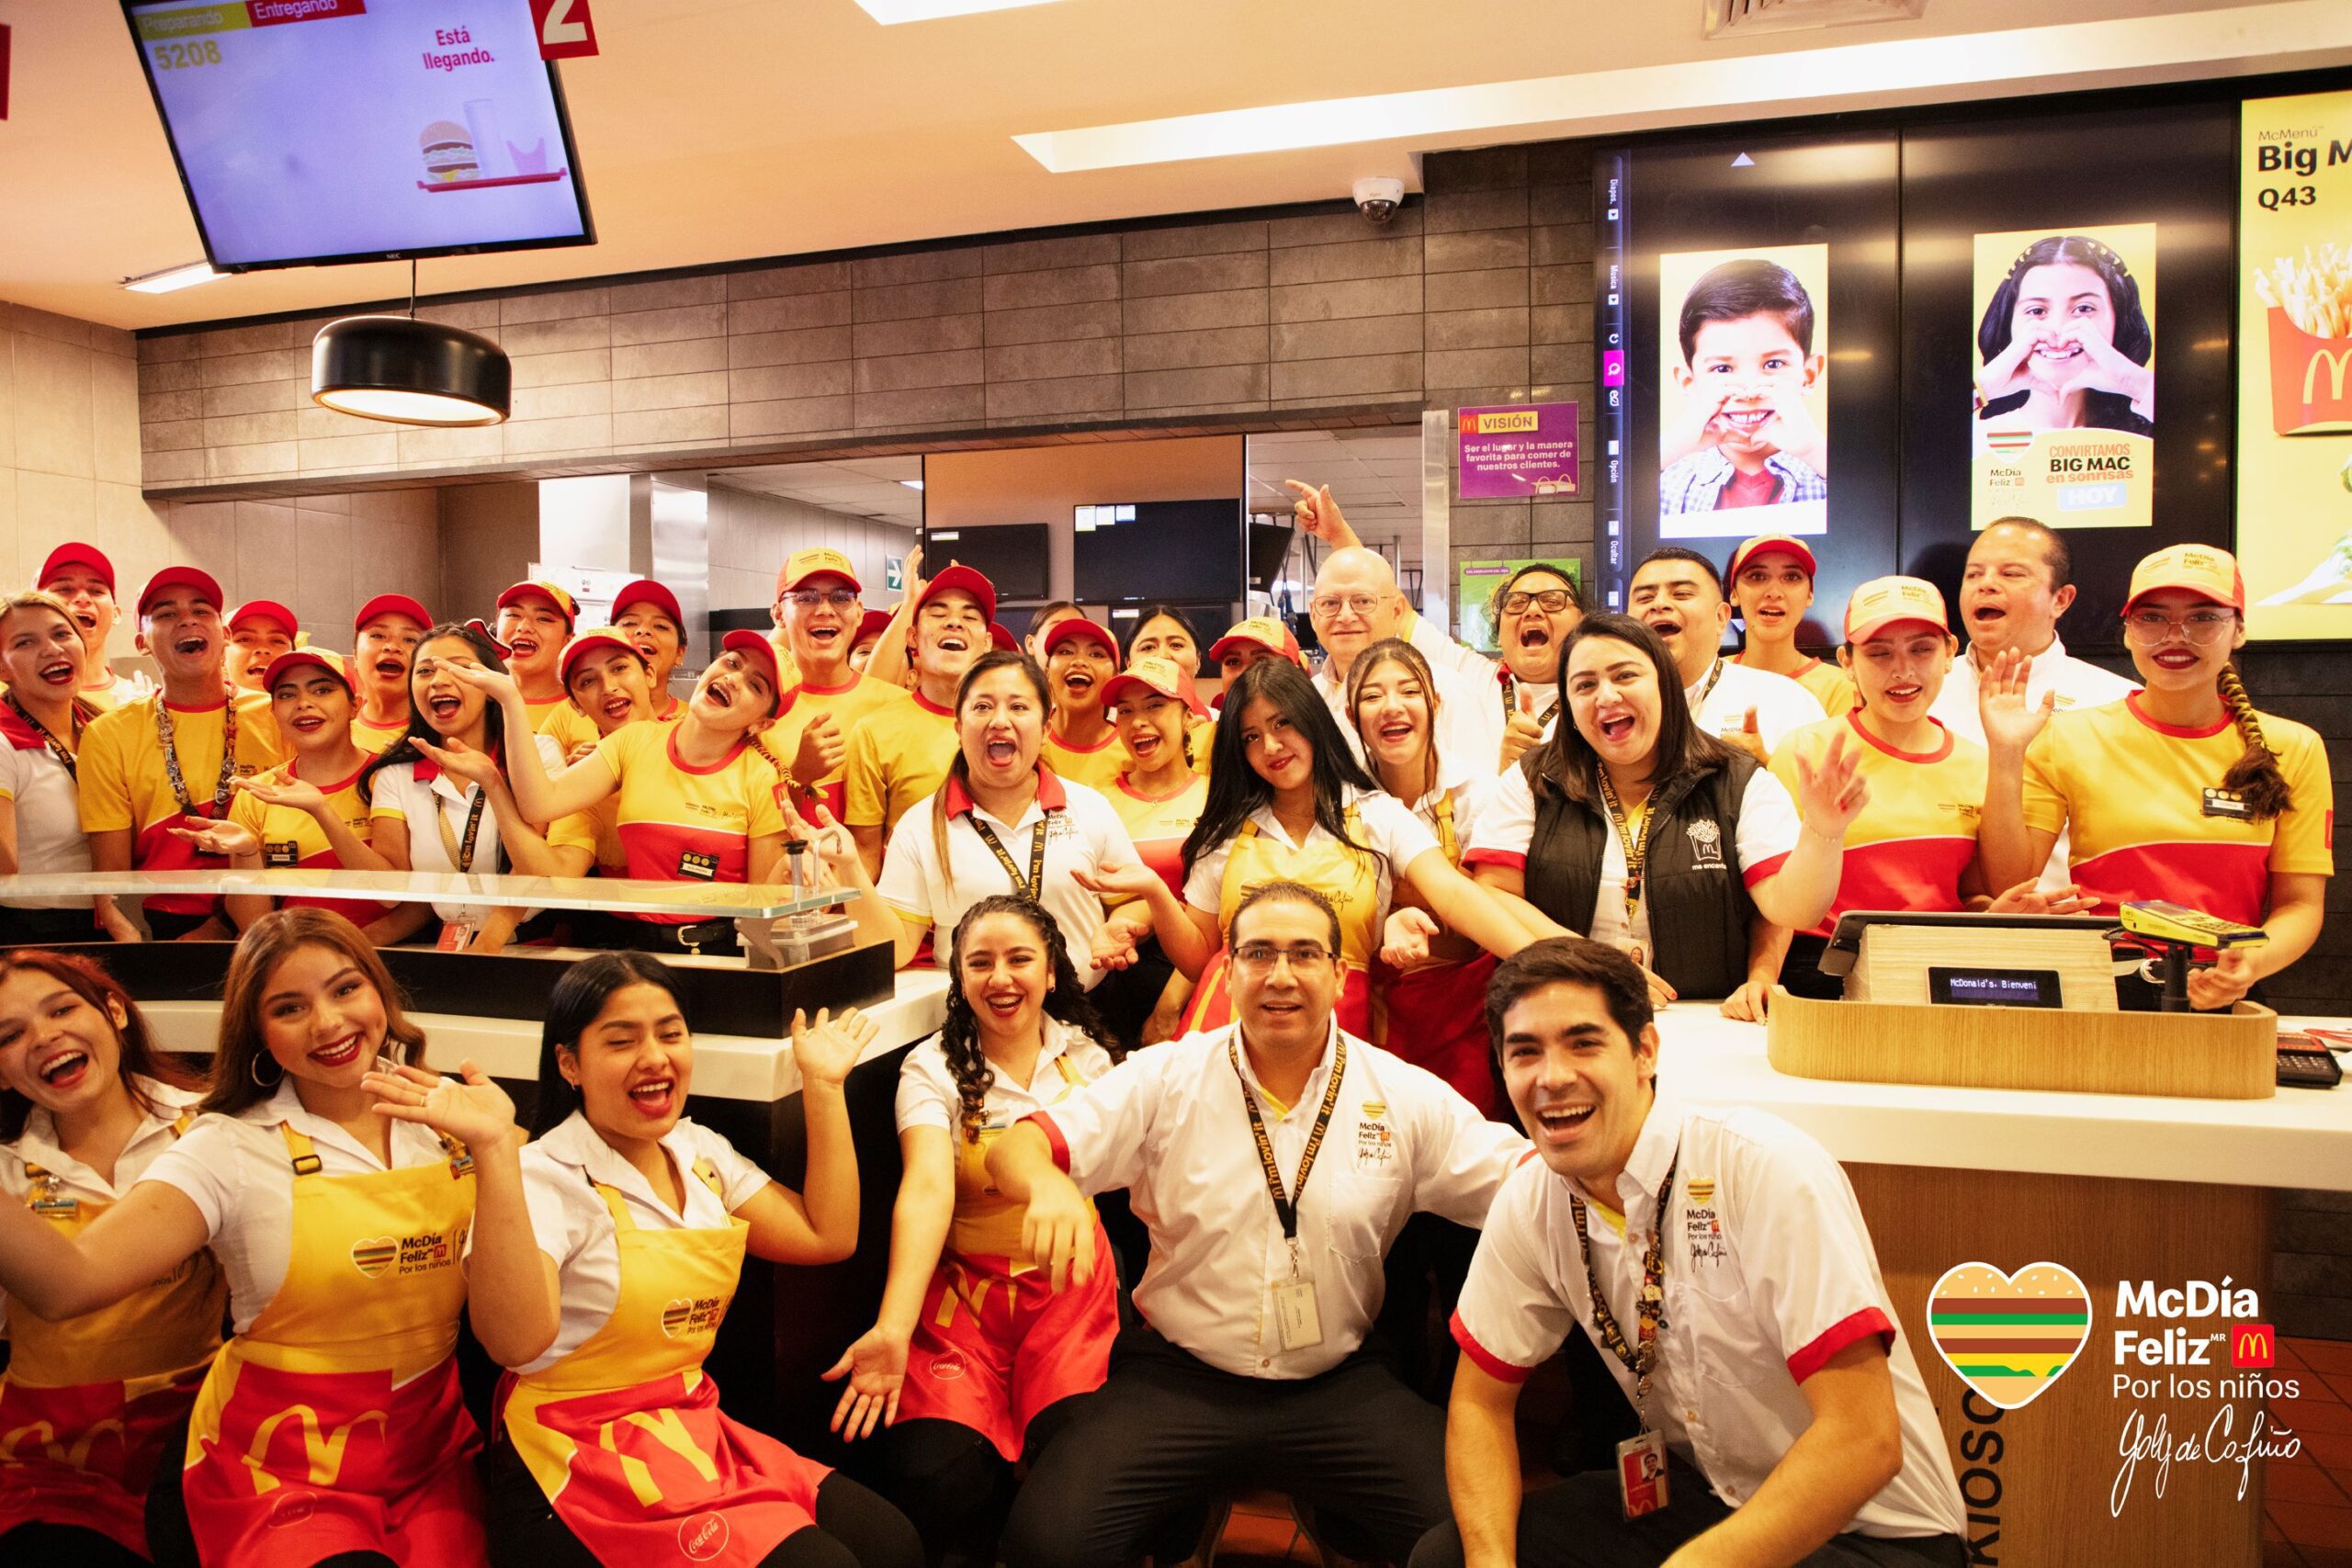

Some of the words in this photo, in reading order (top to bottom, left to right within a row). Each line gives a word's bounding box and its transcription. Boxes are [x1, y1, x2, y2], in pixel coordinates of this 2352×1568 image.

[254, 0, 338, 19] Entregando
[142, 10, 224, 32] Preparando
[435, 25, 470, 46] Está
[153, 39, 221, 71] 5208
[423, 47, 495, 72] llegando.
[2258, 141, 2317, 177] Big
[2257, 186, 2317, 211] Q43
[1483, 414, 1532, 430] VISIÓN
[1464, 445, 1480, 453] Ser
[1482, 444, 1490, 452] el
[1519, 444, 1524, 452] y
[1526, 442, 1535, 450] la
[1537, 441, 1573, 449] manera
[1466, 453, 1502, 462] favorita
[1504, 453, 1526, 462] para
[1527, 451, 1557, 459] comer
[1559, 449, 1571, 457] de
[2049, 444, 2131, 458] CONVIRTAMOS
[1476, 462, 1518, 471] nuestros
[1520, 460, 1560, 469] clientes.
[2050, 458, 2083, 472] BIG
[2087, 457, 2131, 471] MAC
[2046, 474, 2065, 484] en
[2068, 468, 2133, 483] sonrisas
[2068, 487, 2119, 504] HOY
[1619, 833, 1636, 860] lovin'
[1000, 854, 1018, 876] lovin'
[1950, 977, 1997, 988] McDonald's.
[2001, 979, 2037, 989] Bienveni
[1325, 1070, 1342, 1104] lovin'
[1253, 1121, 1262, 1131] it
[1255, 1131, 1273, 1165] lovin'
[1306, 1135, 1322, 1155] i'm
[1267, 1164, 1280, 1183] i'm
[1295, 1154, 1315, 1190] lovin'
[1688, 1222, 1707, 1231] Feliz
[401, 1232, 442, 1249] McDía
[400, 1249, 428, 1264] Feliz
[399, 1266, 413, 1275] Por
[414, 1264, 427, 1272] los
[428, 1258, 452, 1269] niños
[1959, 1388, 2005, 1566] KIOSC
